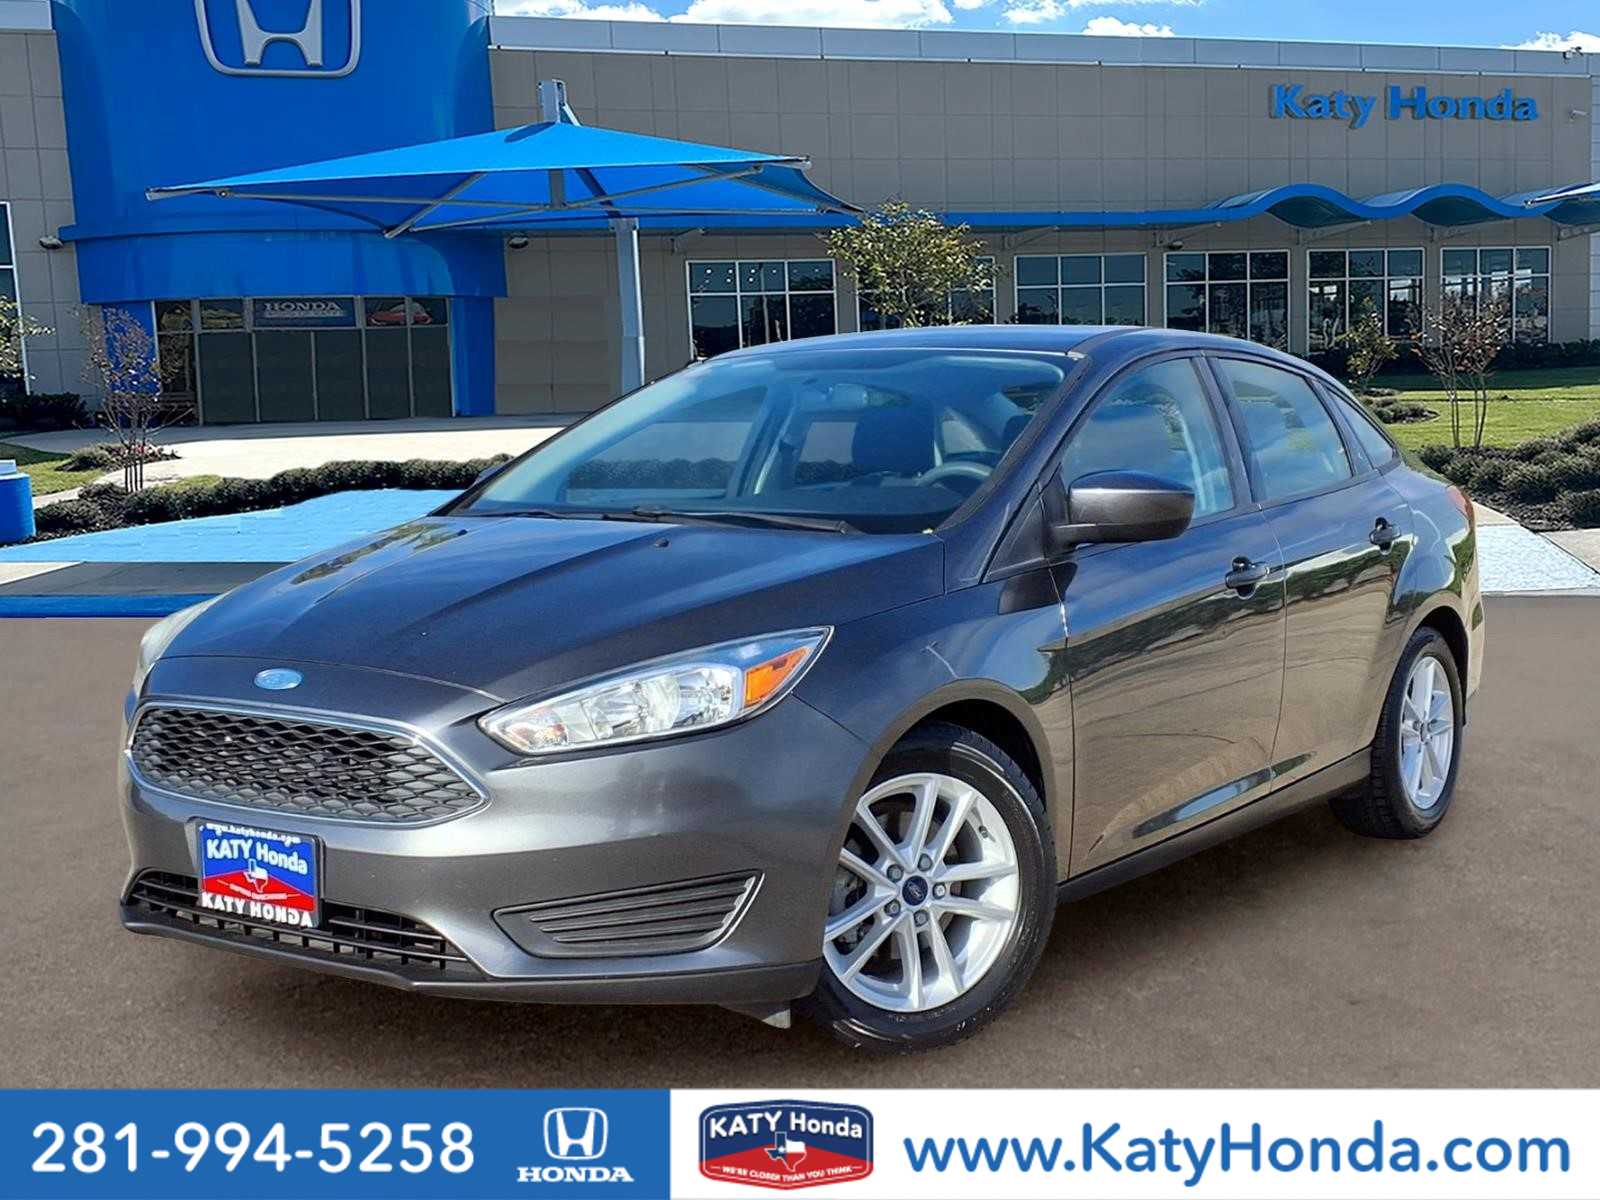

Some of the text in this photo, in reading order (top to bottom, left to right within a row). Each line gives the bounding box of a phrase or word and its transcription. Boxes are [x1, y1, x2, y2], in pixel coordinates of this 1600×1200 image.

[1271, 84, 1539, 129] Katy Honda
[264, 302, 342, 311] HONDA
[206, 838, 308, 876] KATY Honda
[201, 892, 313, 928] KATY HONDA
